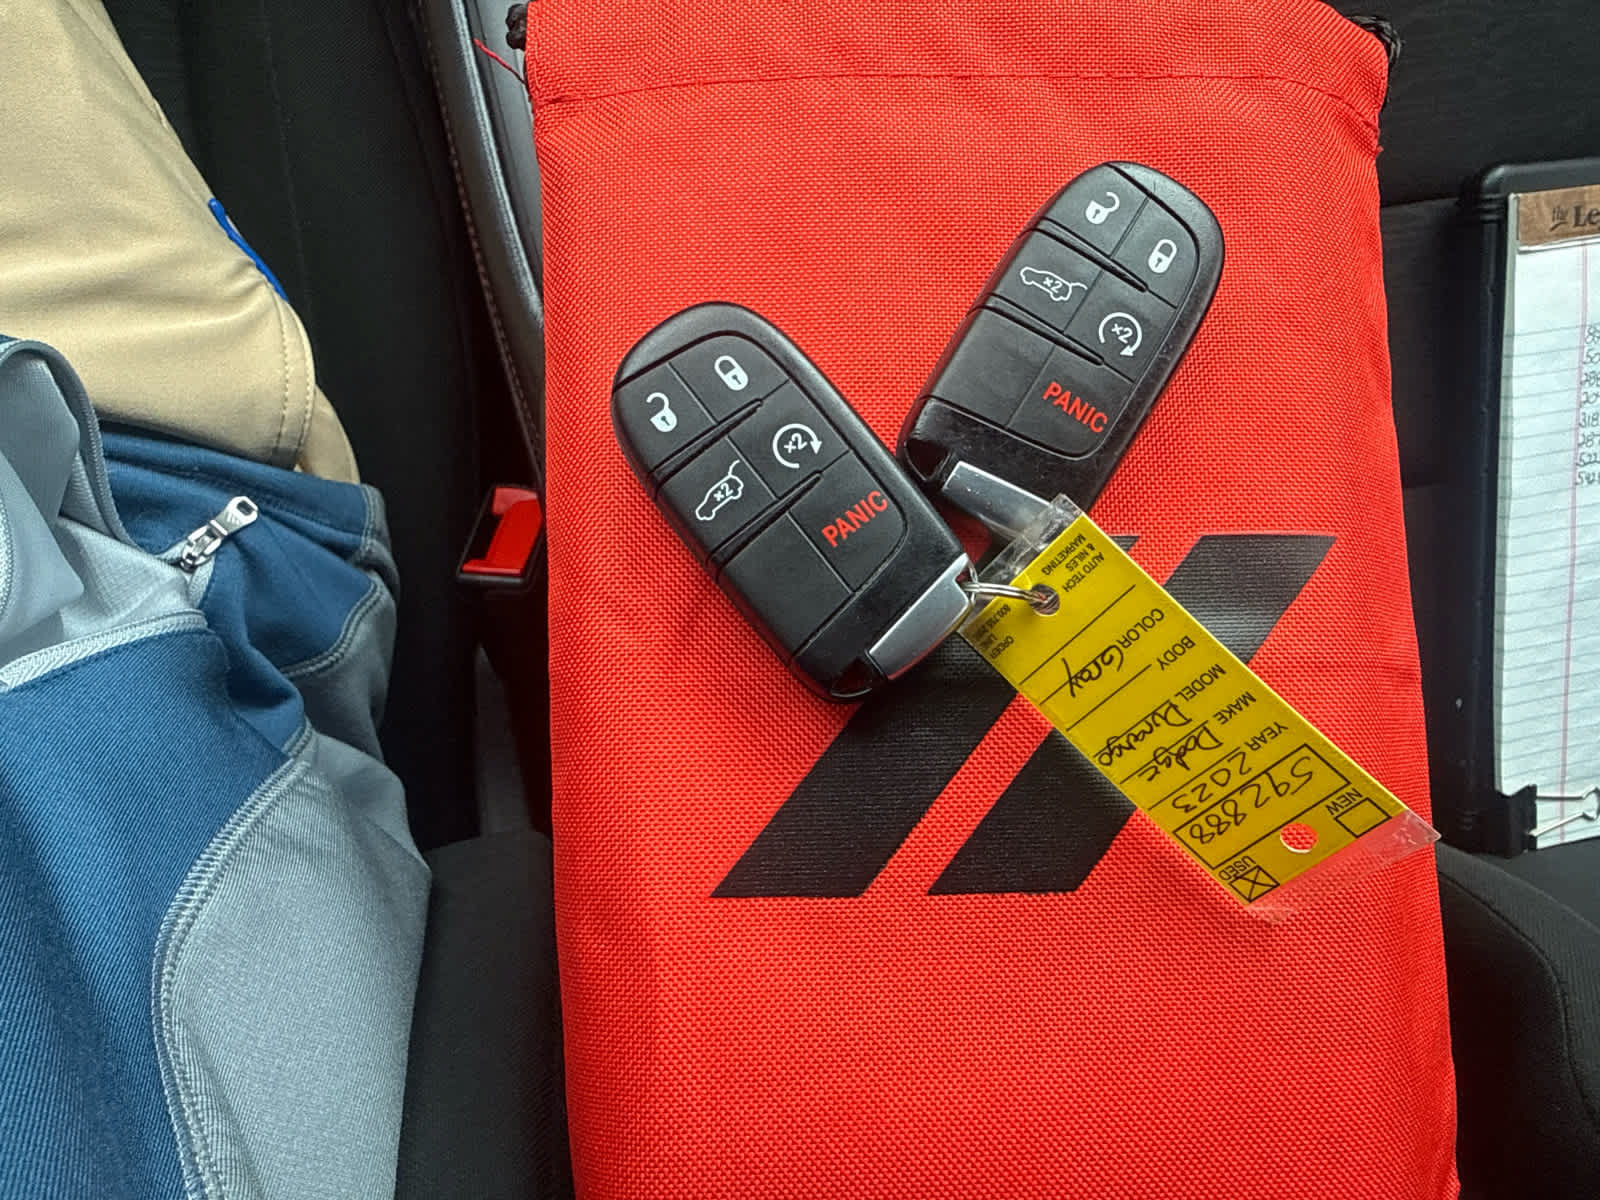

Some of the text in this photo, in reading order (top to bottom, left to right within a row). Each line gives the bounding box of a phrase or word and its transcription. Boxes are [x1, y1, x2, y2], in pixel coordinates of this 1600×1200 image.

[1042, 381, 1108, 433] PANIC
[821, 490, 889, 547] PANIC
[1041, 533, 1087, 576] MARKETING
[1062, 551, 1105, 592] AUTO TECH
[1065, 549, 1090, 572] NILES
[1062, 607, 1165, 698] COLOR Gray
[1156, 635, 1196, 671] BODY
[1095, 663, 1227, 767] MODEL Durango
[1137, 691, 1257, 783] MAKE Dodge
[1171, 721, 1289, 814] YEAR 2023
[1189, 756, 1313, 844] 592888
[1325, 788, 1363, 816] NEW
[1217, 855, 1256, 881] USED
